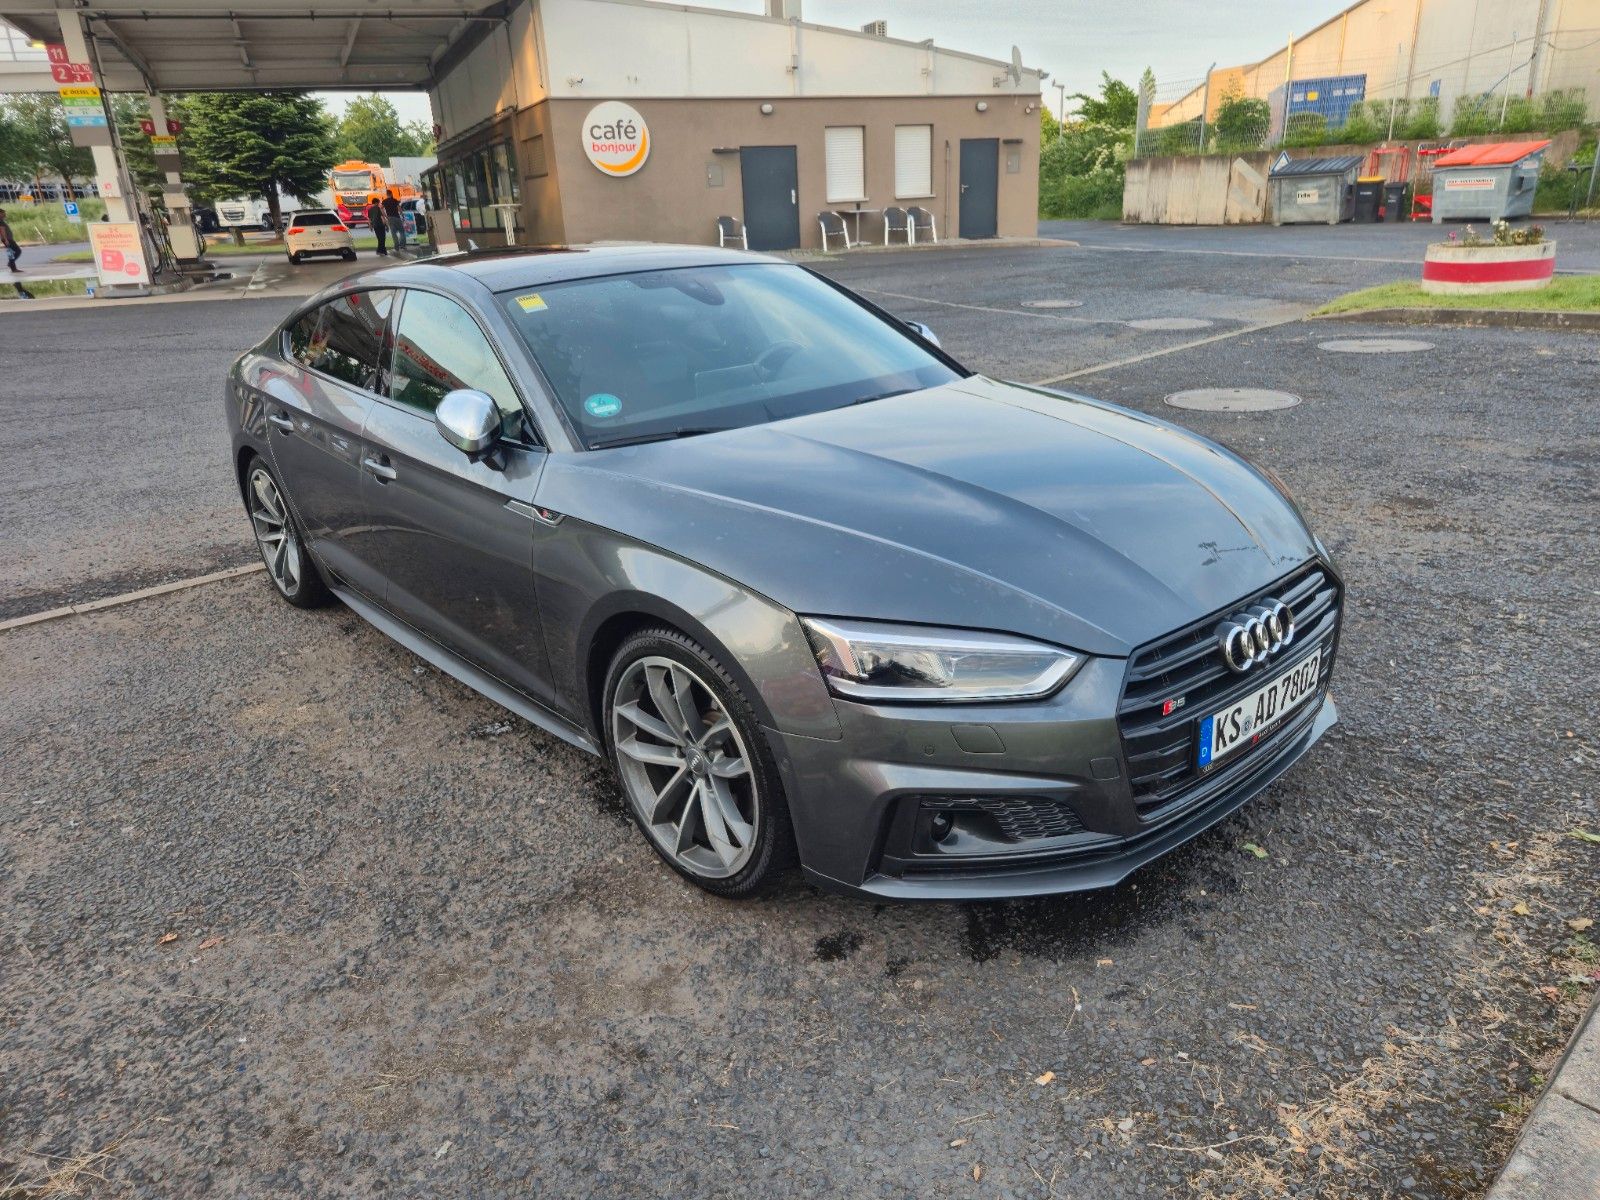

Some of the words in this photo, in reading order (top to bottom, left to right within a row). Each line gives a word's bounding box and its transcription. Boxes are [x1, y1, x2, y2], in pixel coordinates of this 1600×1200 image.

[50, 48, 64, 60] 11
[57, 68, 68, 80] 2
[590, 119, 636, 140] café
[592, 142, 637, 154] bonjour
[67, 204, 75, 214] P
[1215, 706, 1242, 753] KS
[1253, 685, 1278, 729] AD
[1281, 656, 1319, 711] 7802
[1201, 747, 1208, 758] D
